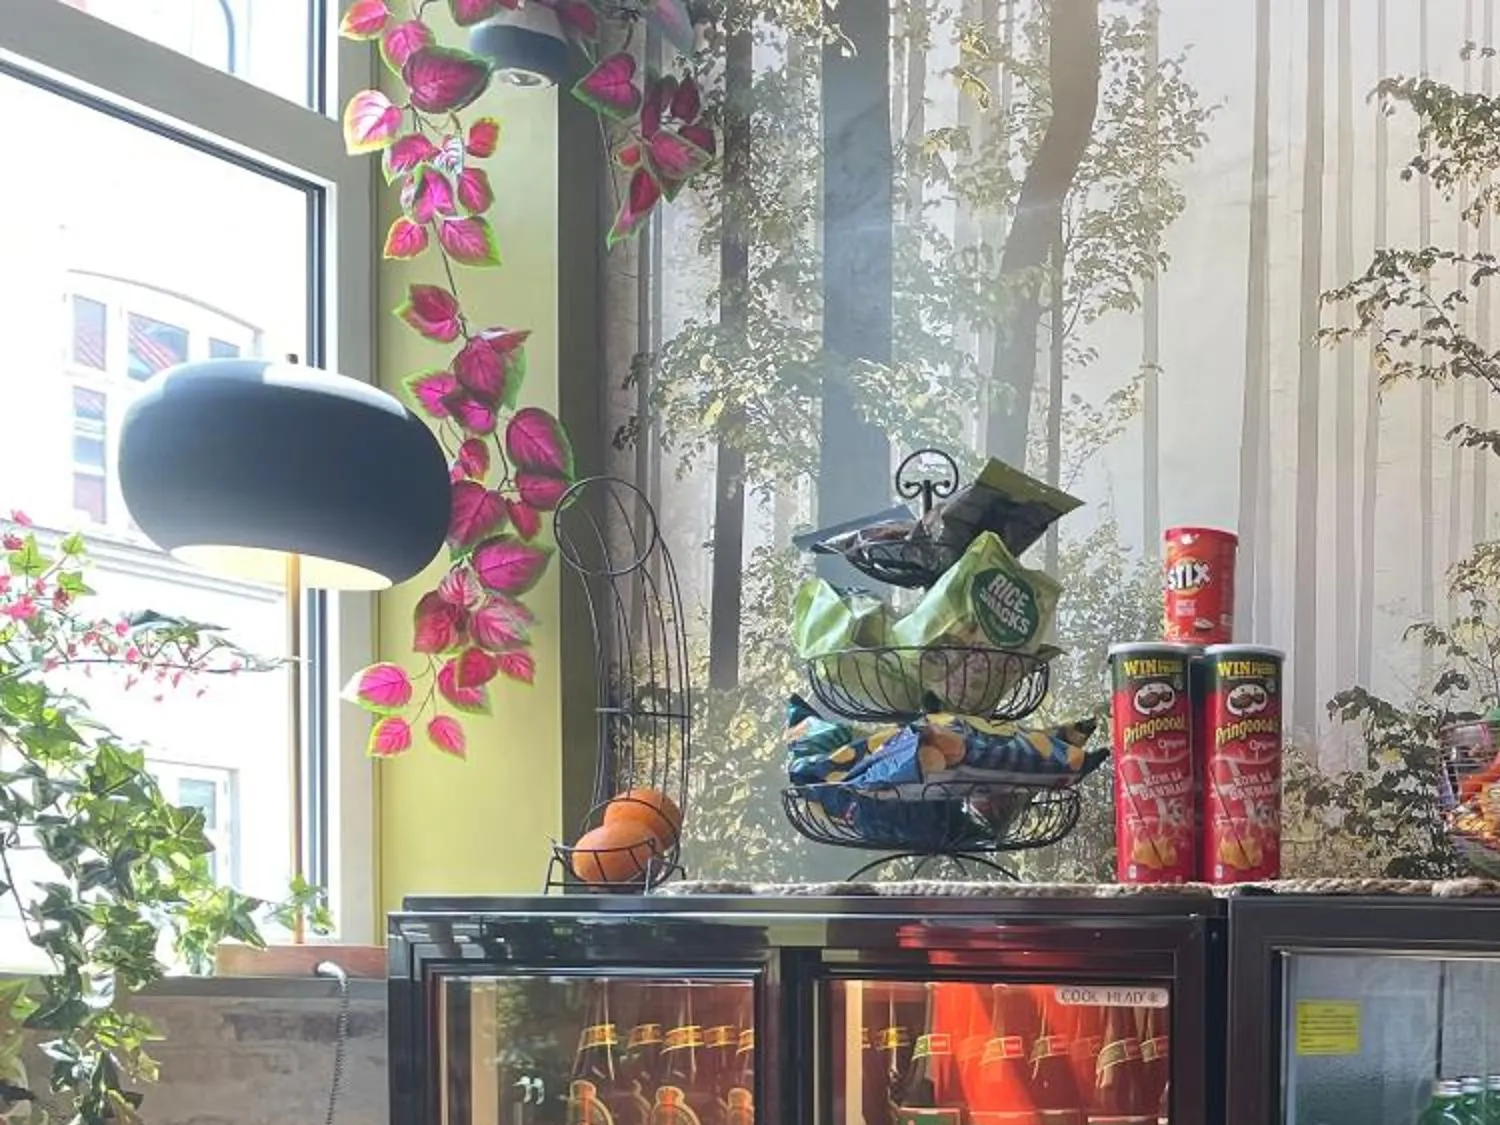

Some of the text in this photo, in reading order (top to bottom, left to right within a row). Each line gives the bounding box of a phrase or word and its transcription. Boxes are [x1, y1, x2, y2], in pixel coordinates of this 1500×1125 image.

[987, 573, 1030, 612] RICE
[1123, 658, 1157, 676] WIN
[1216, 661, 1250, 677] WIN
